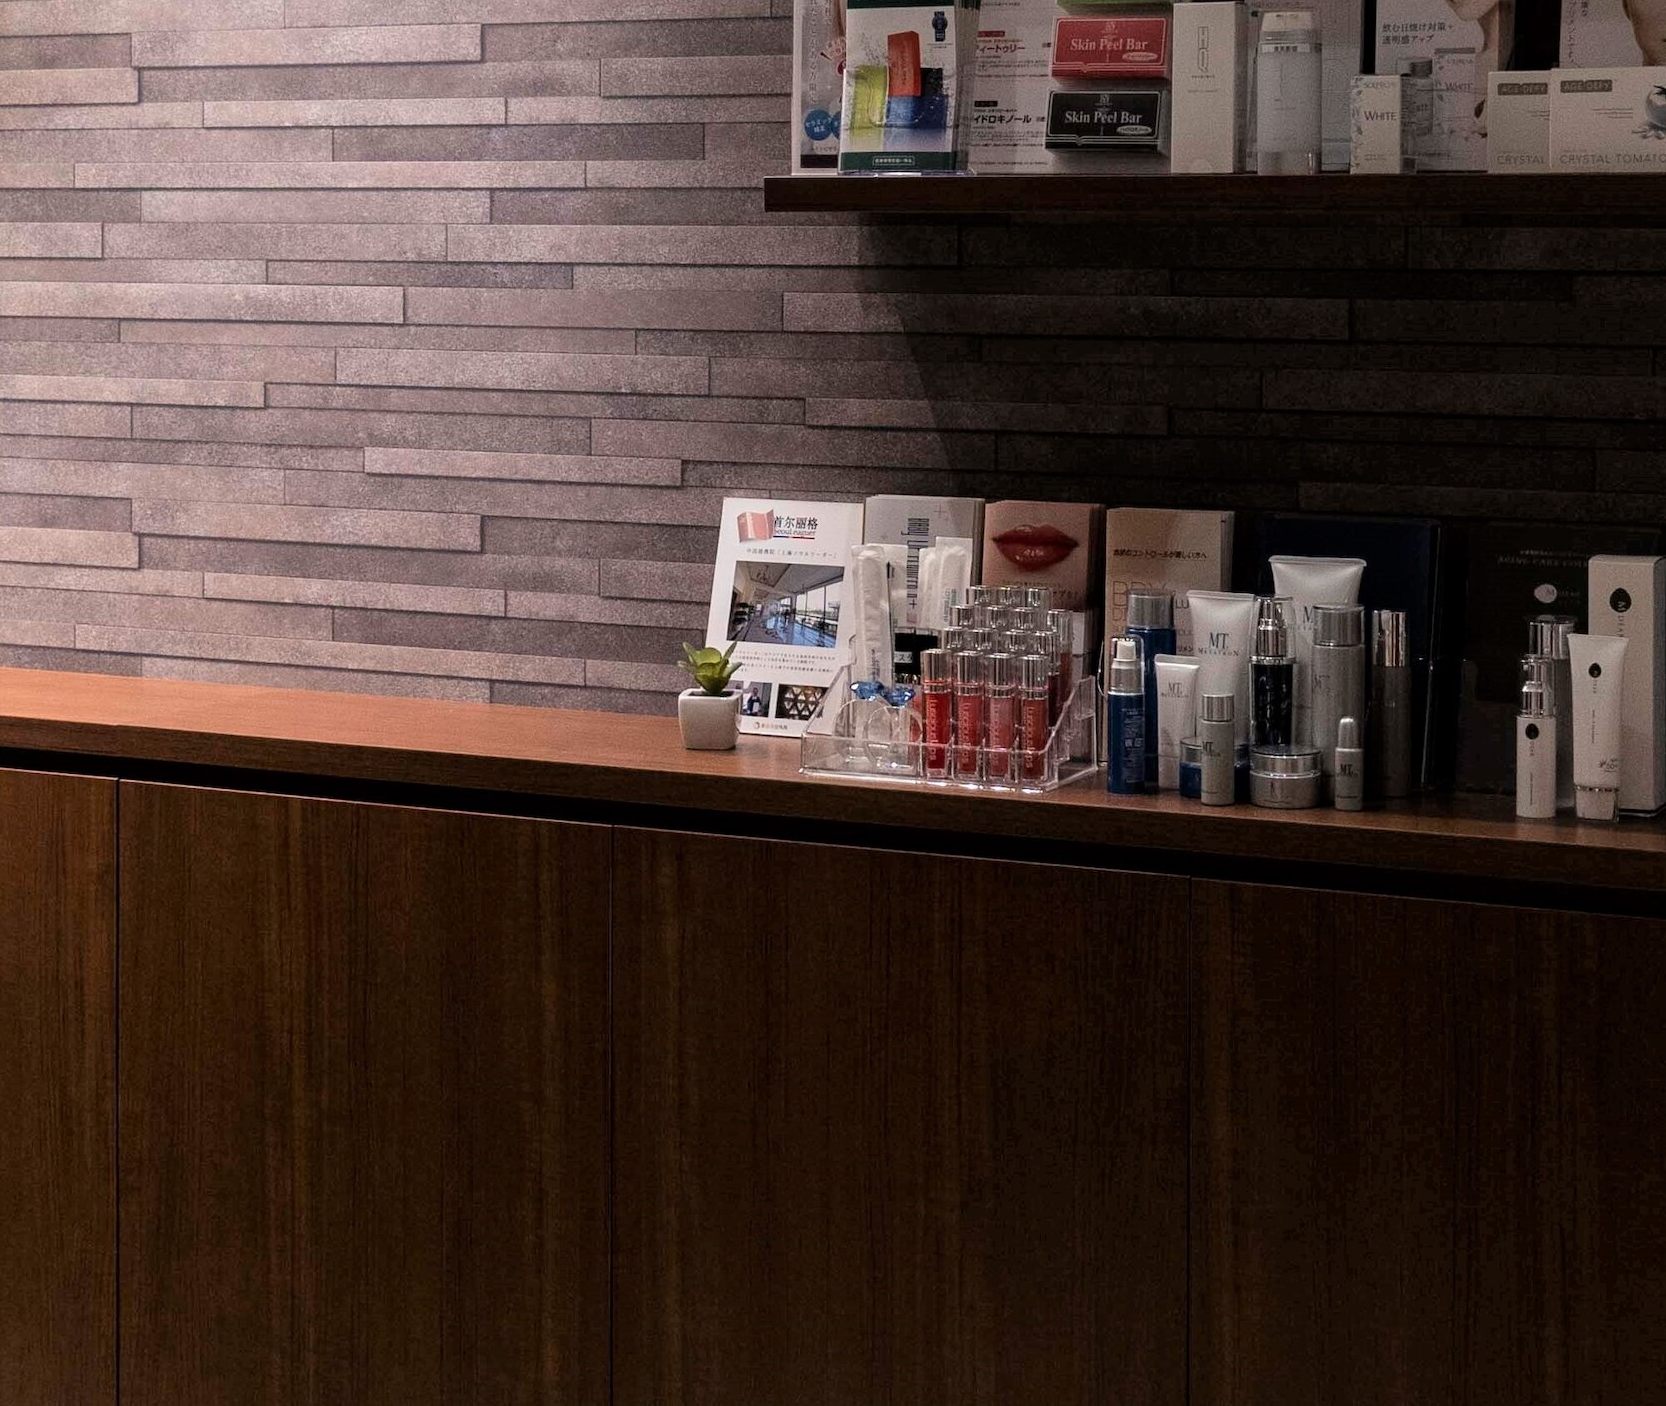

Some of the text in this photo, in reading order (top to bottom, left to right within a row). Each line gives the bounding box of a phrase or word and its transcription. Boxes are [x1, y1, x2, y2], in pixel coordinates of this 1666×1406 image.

[1071, 38, 1148, 51] Skin Peel Bar
[1064, 110, 1143, 123] Skin Peel Bar
[1363, 110, 1398, 121] WHITE
[1497, 154, 1546, 165] CRYSTAL
[1559, 153, 1611, 164] CRYSTAL
